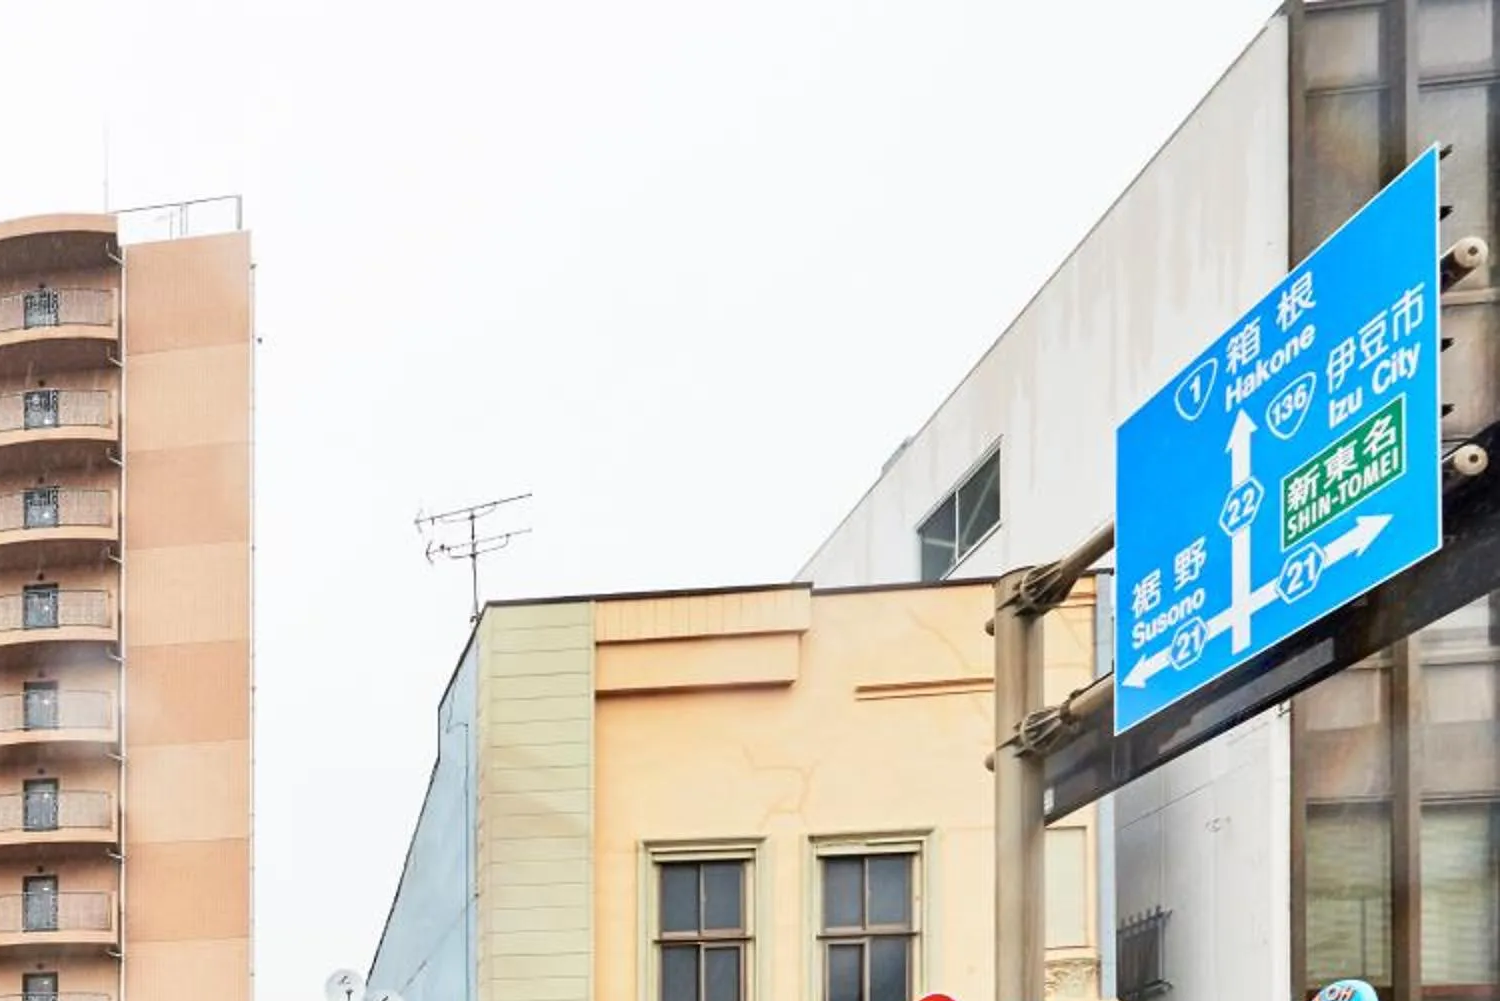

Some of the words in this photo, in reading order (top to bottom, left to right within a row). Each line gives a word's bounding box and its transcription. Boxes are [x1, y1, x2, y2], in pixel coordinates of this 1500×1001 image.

[1226, 271, 1316, 377] 箱根
[1326, 282, 1425, 394] 伊豆市
[1189, 375, 1201, 404] 1
[1226, 324, 1316, 412] Hakone
[1269, 380, 1308, 427] 136
[1329, 387, 1362, 429] Izu
[1372, 342, 1421, 394] City
[1286, 414, 1397, 513] 新東名
[1287, 447, 1399, 540] SHIN-TOMEI
[1227, 487, 1256, 525] 22
[1132, 536, 1207, 618] 裾野
[1287, 552, 1317, 594] 21
[1131, 587, 1206, 650] Susono
[1176, 627, 1200, 659] 21
